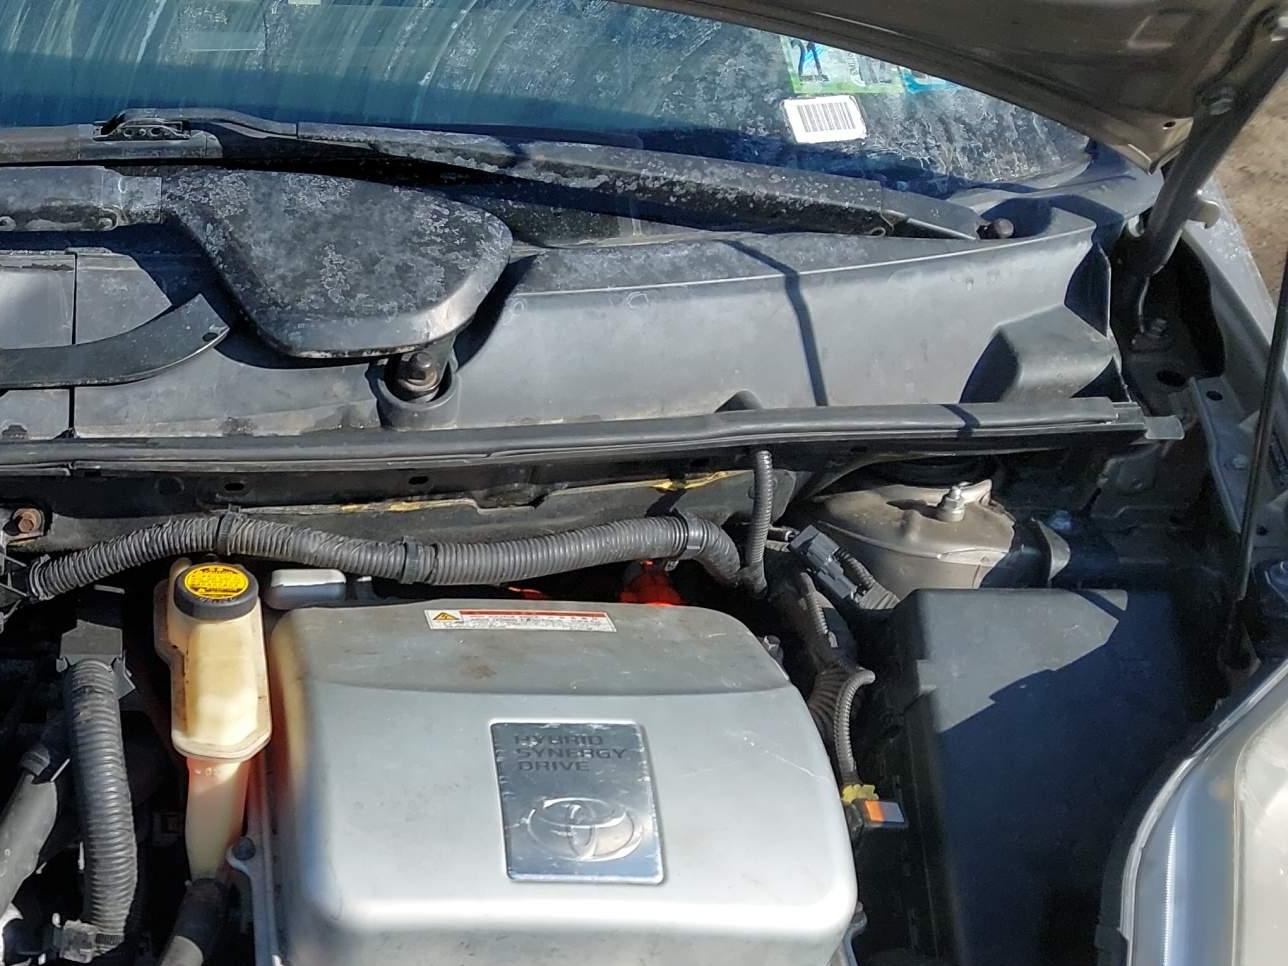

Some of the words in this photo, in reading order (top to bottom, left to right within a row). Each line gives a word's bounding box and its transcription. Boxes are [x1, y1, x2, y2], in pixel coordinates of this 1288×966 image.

[514, 734, 603, 746] HYBRID
[515, 748, 626, 760] SYNERGY
[518, 760, 591, 772] DRIVE
